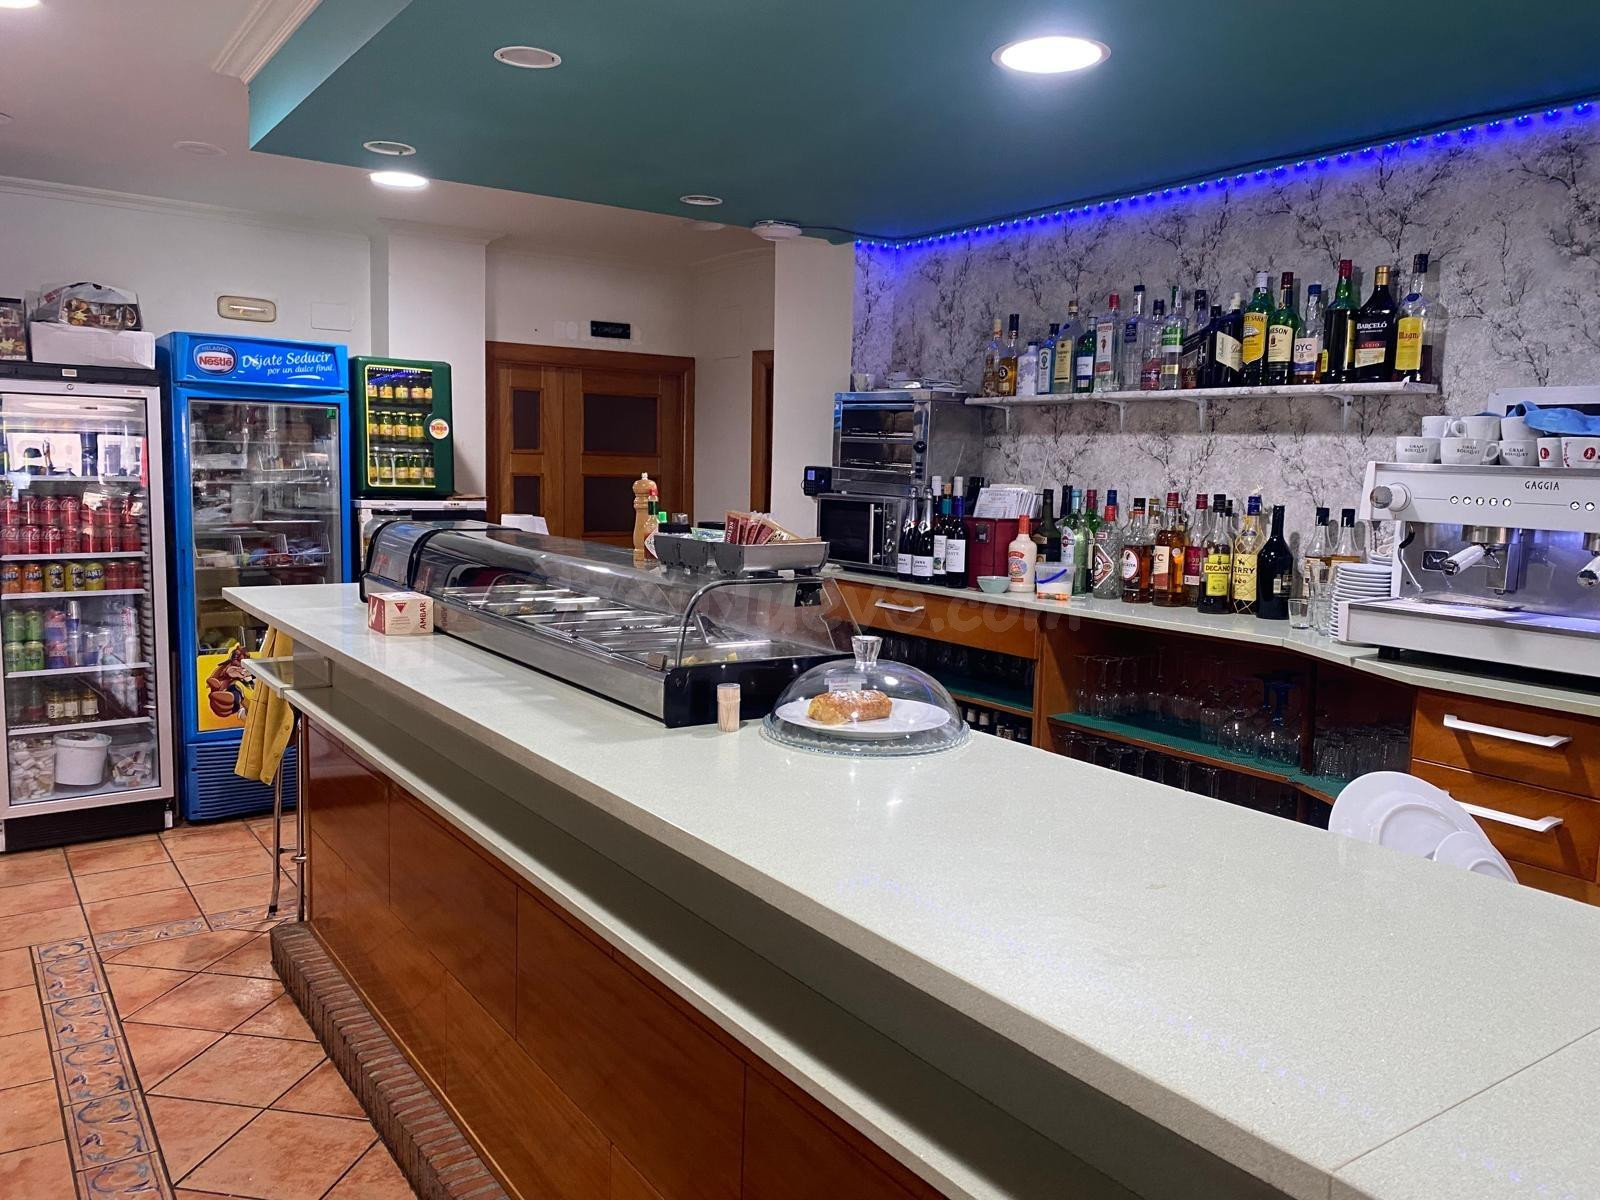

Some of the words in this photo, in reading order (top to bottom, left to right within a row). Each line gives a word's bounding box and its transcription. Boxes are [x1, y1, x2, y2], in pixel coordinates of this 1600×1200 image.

[1357, 321, 1387, 330] BARCELÓ
[199, 355, 233, 368] Nestlé
[286, 351, 331, 365] Seducir
[267, 366, 280, 376] por
[295, 364, 314, 373] dulce
[1524, 480, 1560, 491] GAGGIA
[726, 521, 735, 544] KETCH
[1233, 566, 1255, 574] ERRY
[419, 602, 428, 630] AMBAR
